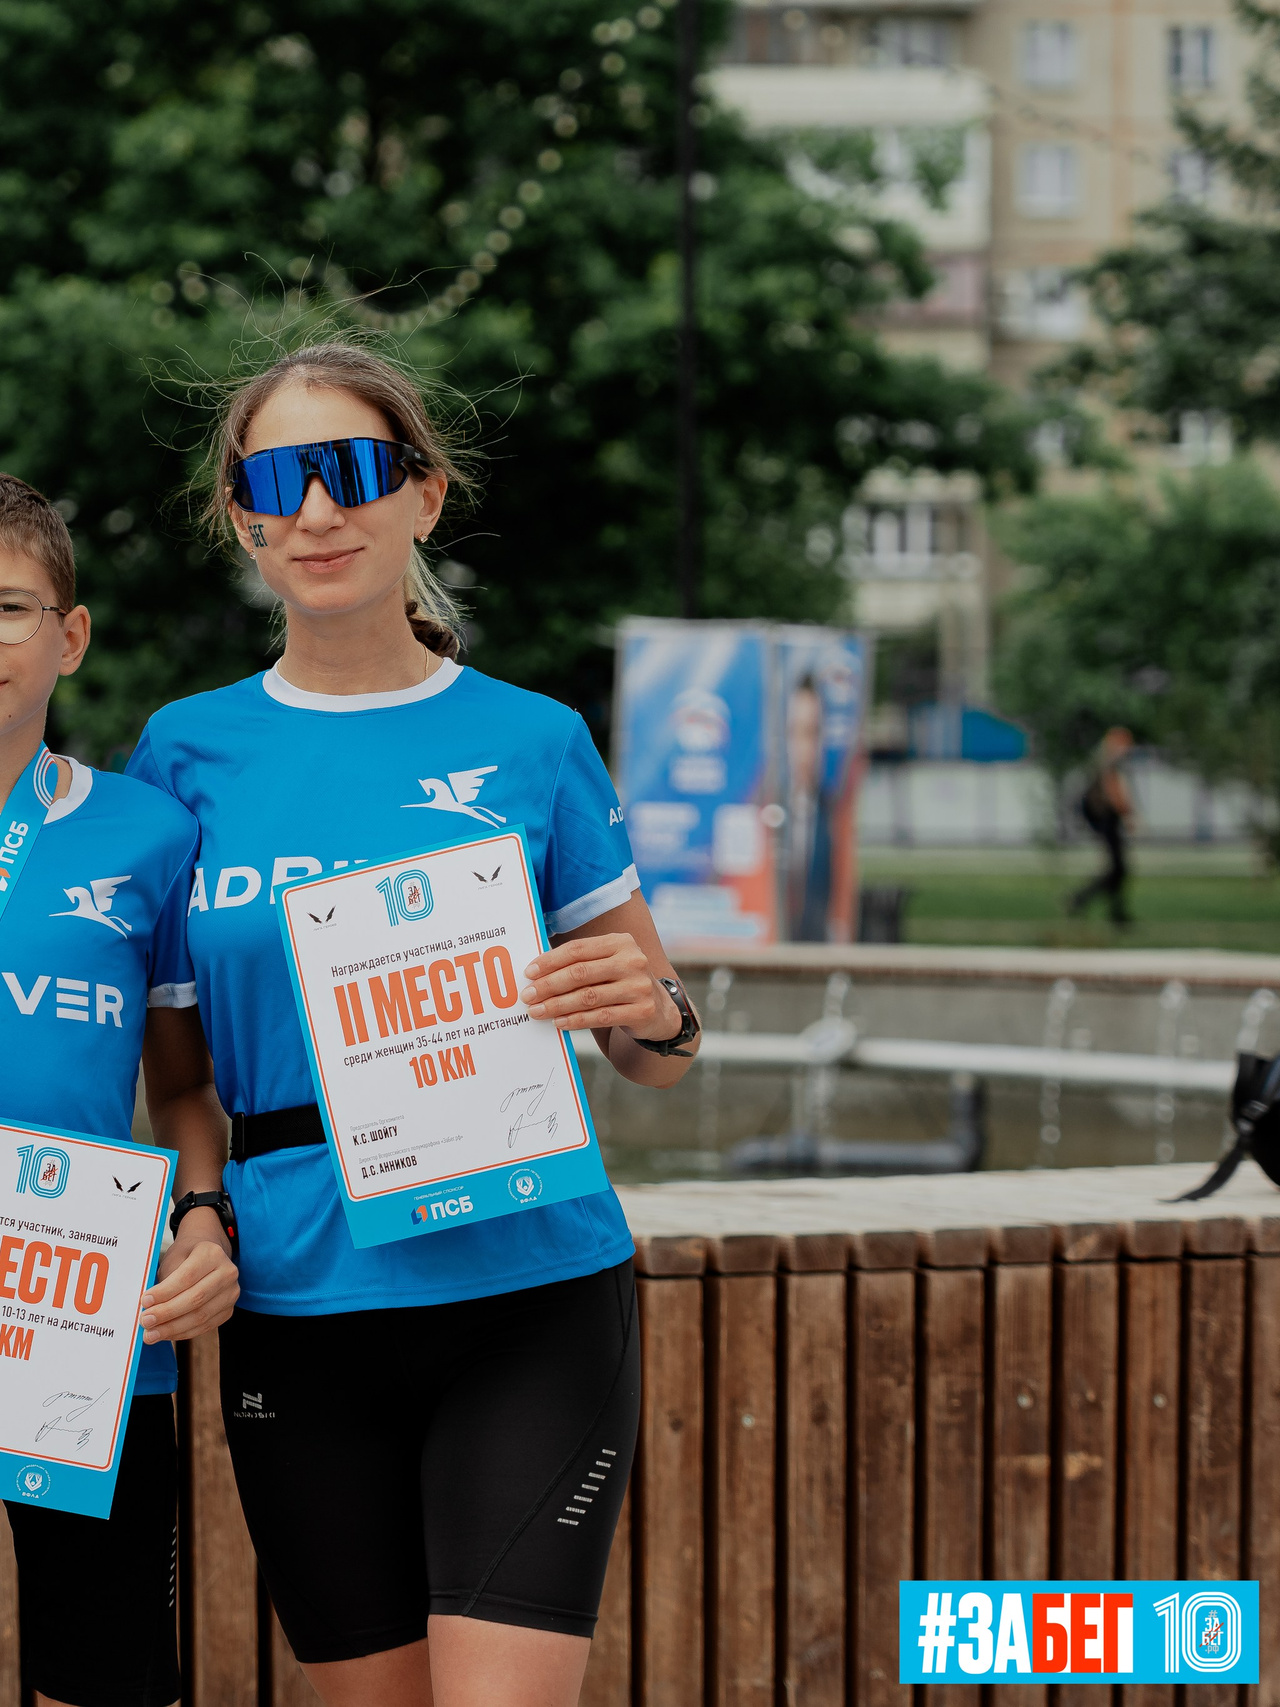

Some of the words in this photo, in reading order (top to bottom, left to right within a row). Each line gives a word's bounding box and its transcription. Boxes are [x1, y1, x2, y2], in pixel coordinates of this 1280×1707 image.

[375, 869, 434, 927] 10
[331, 953, 401, 978] Награждается
[403, 938, 457, 962] участница,
[458, 926, 506, 946] занявшая
[333, 981, 370, 1047] II
[368, 945, 519, 1039] МЕСТО
[343, 1052, 373, 1068] среди
[374, 1041, 415, 1059] женщин
[416, 1032, 443, 1049] 35-44
[445, 1029, 461, 1042] лет
[464, 1026, 475, 1037] на
[478, 1013, 530, 1035] дистанции
[409, 1053, 438, 1088] 10
[438, 1043, 477, 1082] КМ
[353, 1133, 370, 1146] К.С.
[370, 1125, 398, 1142] ШОЙГУ
[16, 1144, 70, 1199] 10
[361, 1165, 379, 1179] Д.С.
[380, 1155, 418, 1174] АННИКОВ
[430, 1195, 474, 1220] ПСБ
[17, 1219, 66, 1238] участник,
[68, 1229, 118, 1247] занявший
[1, 1305, 26, 1321] 10-13
[27, 1312, 45, 1324] лет
[47, 1316, 59, 1327] на
[60, 1320, 115, 1338] дистанции
